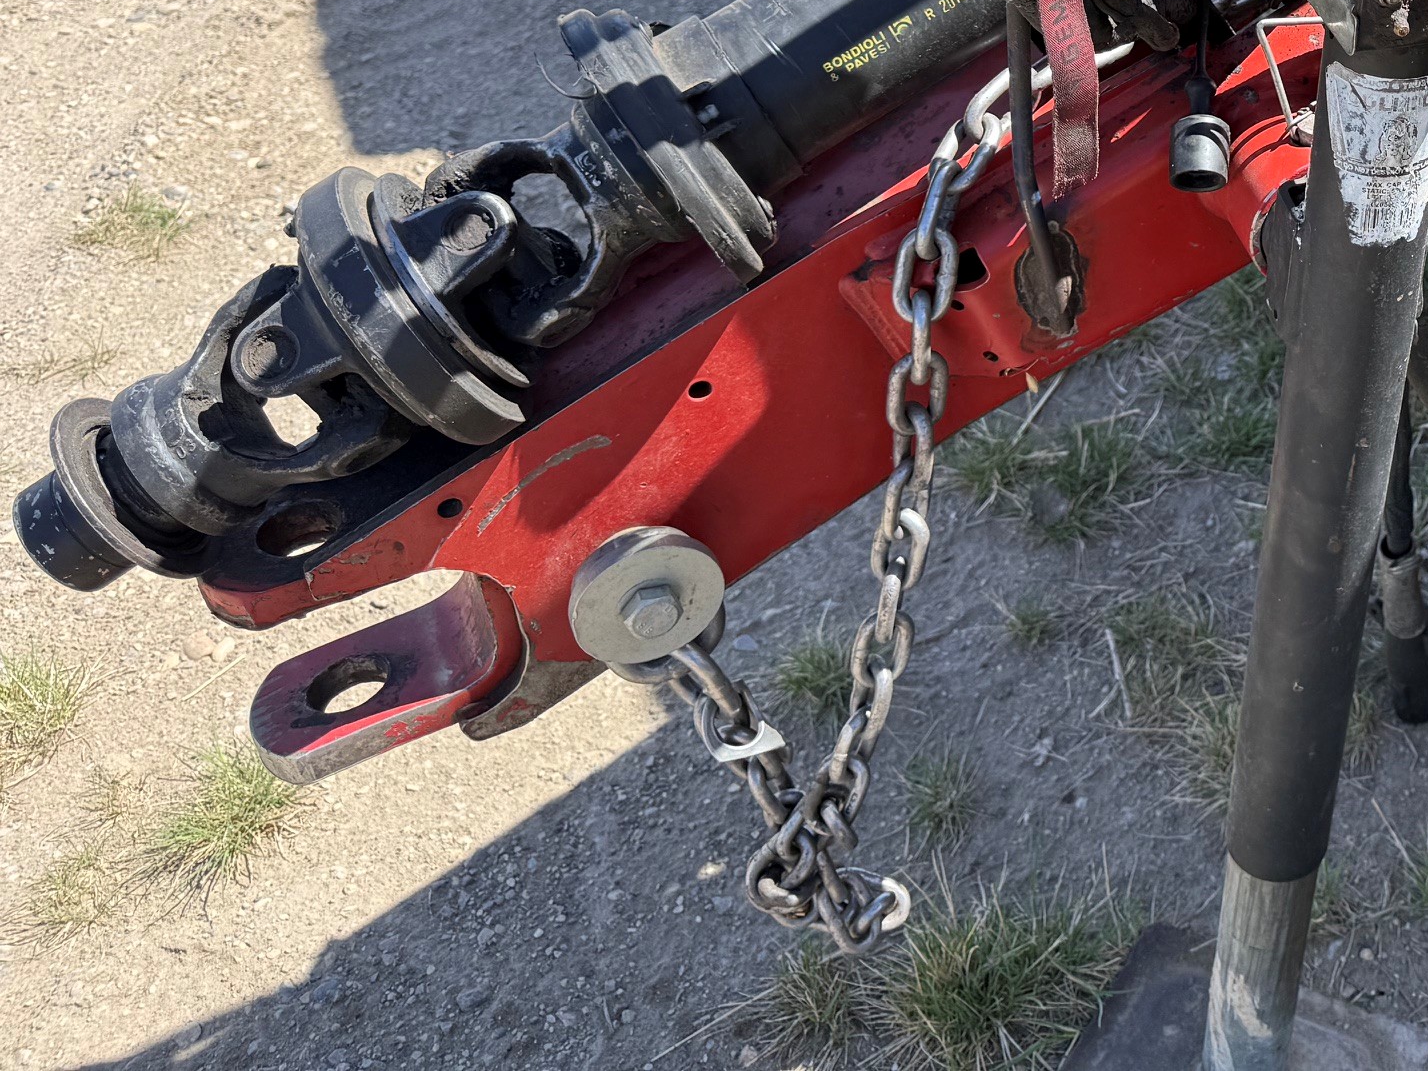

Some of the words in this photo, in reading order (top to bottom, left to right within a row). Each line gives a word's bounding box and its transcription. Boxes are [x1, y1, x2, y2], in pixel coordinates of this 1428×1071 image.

[822, 30, 887, 73] BONDIOLI
[924, 7, 937, 21] R
[844, 40, 891, 73] PAVESI
